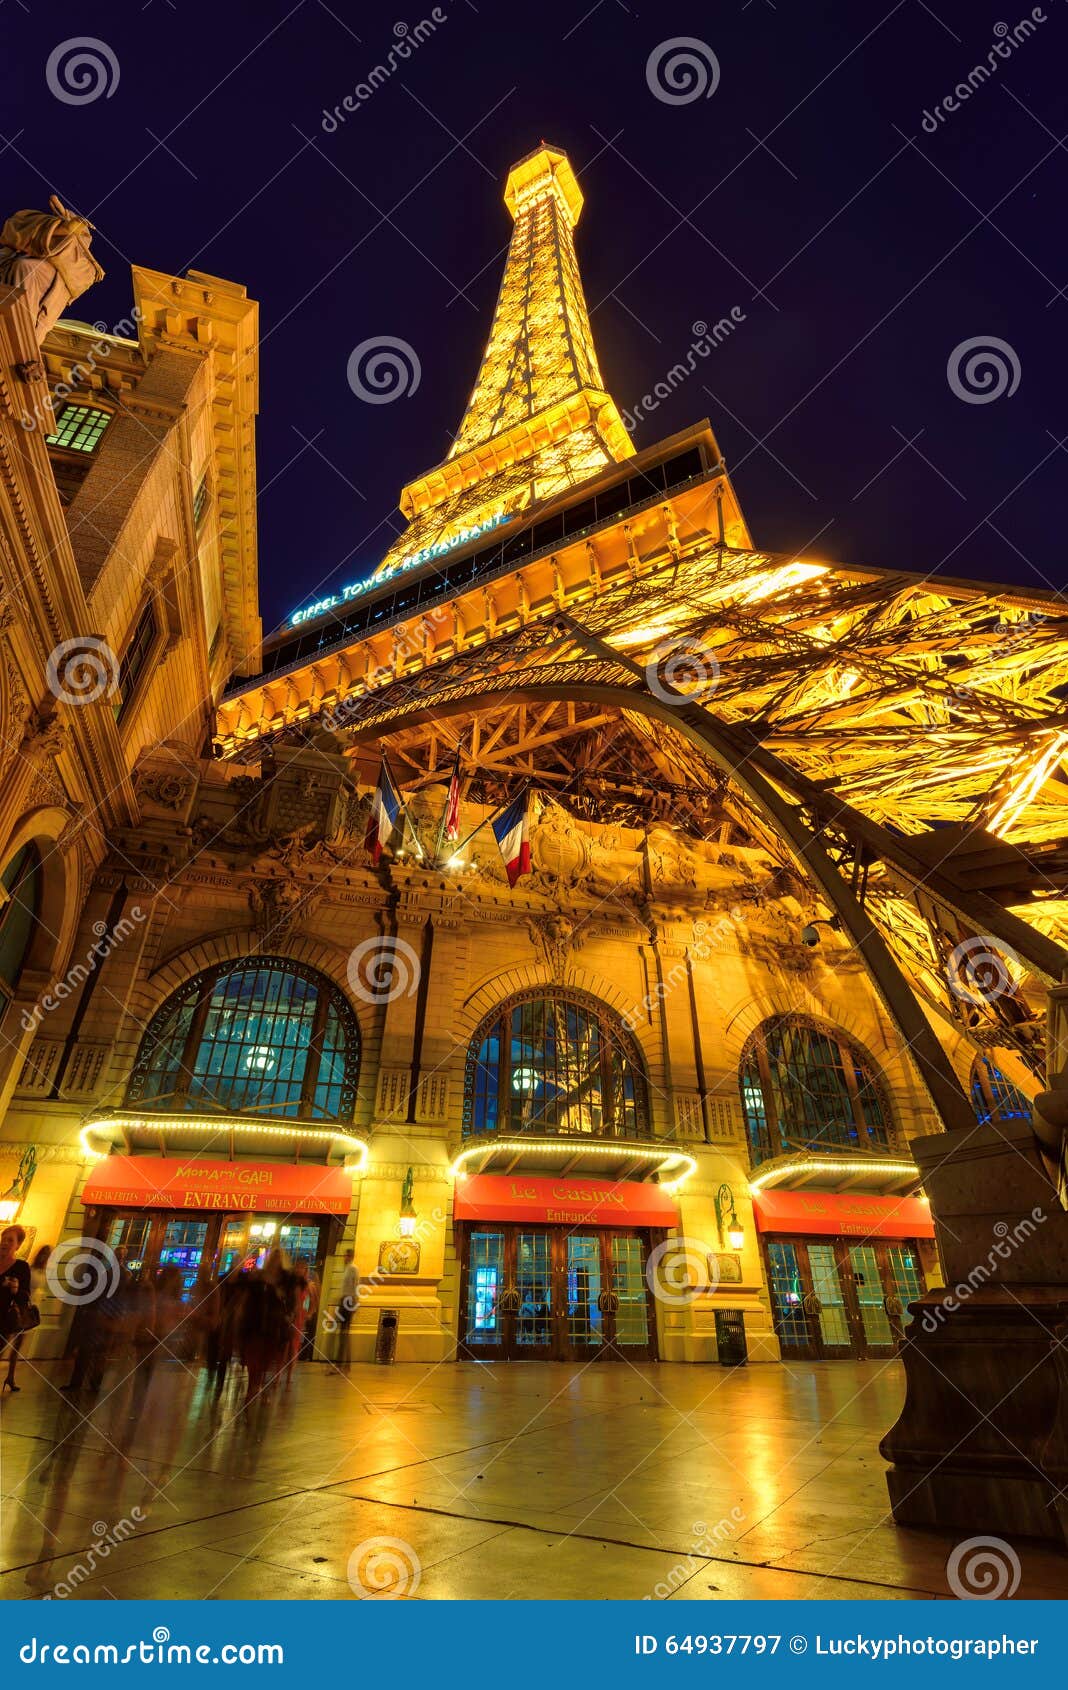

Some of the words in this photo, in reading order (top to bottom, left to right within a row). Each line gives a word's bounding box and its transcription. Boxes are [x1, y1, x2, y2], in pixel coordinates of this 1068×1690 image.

[291, 595, 339, 625] EIFFEL
[343, 566, 394, 596] TOWER
[402, 512, 503, 570] RESTAURANT
[510, 1183, 536, 1199] Le
[183, 1191, 258, 1209] ENTRANCE
[546, 1209, 598, 1223] Entrance
